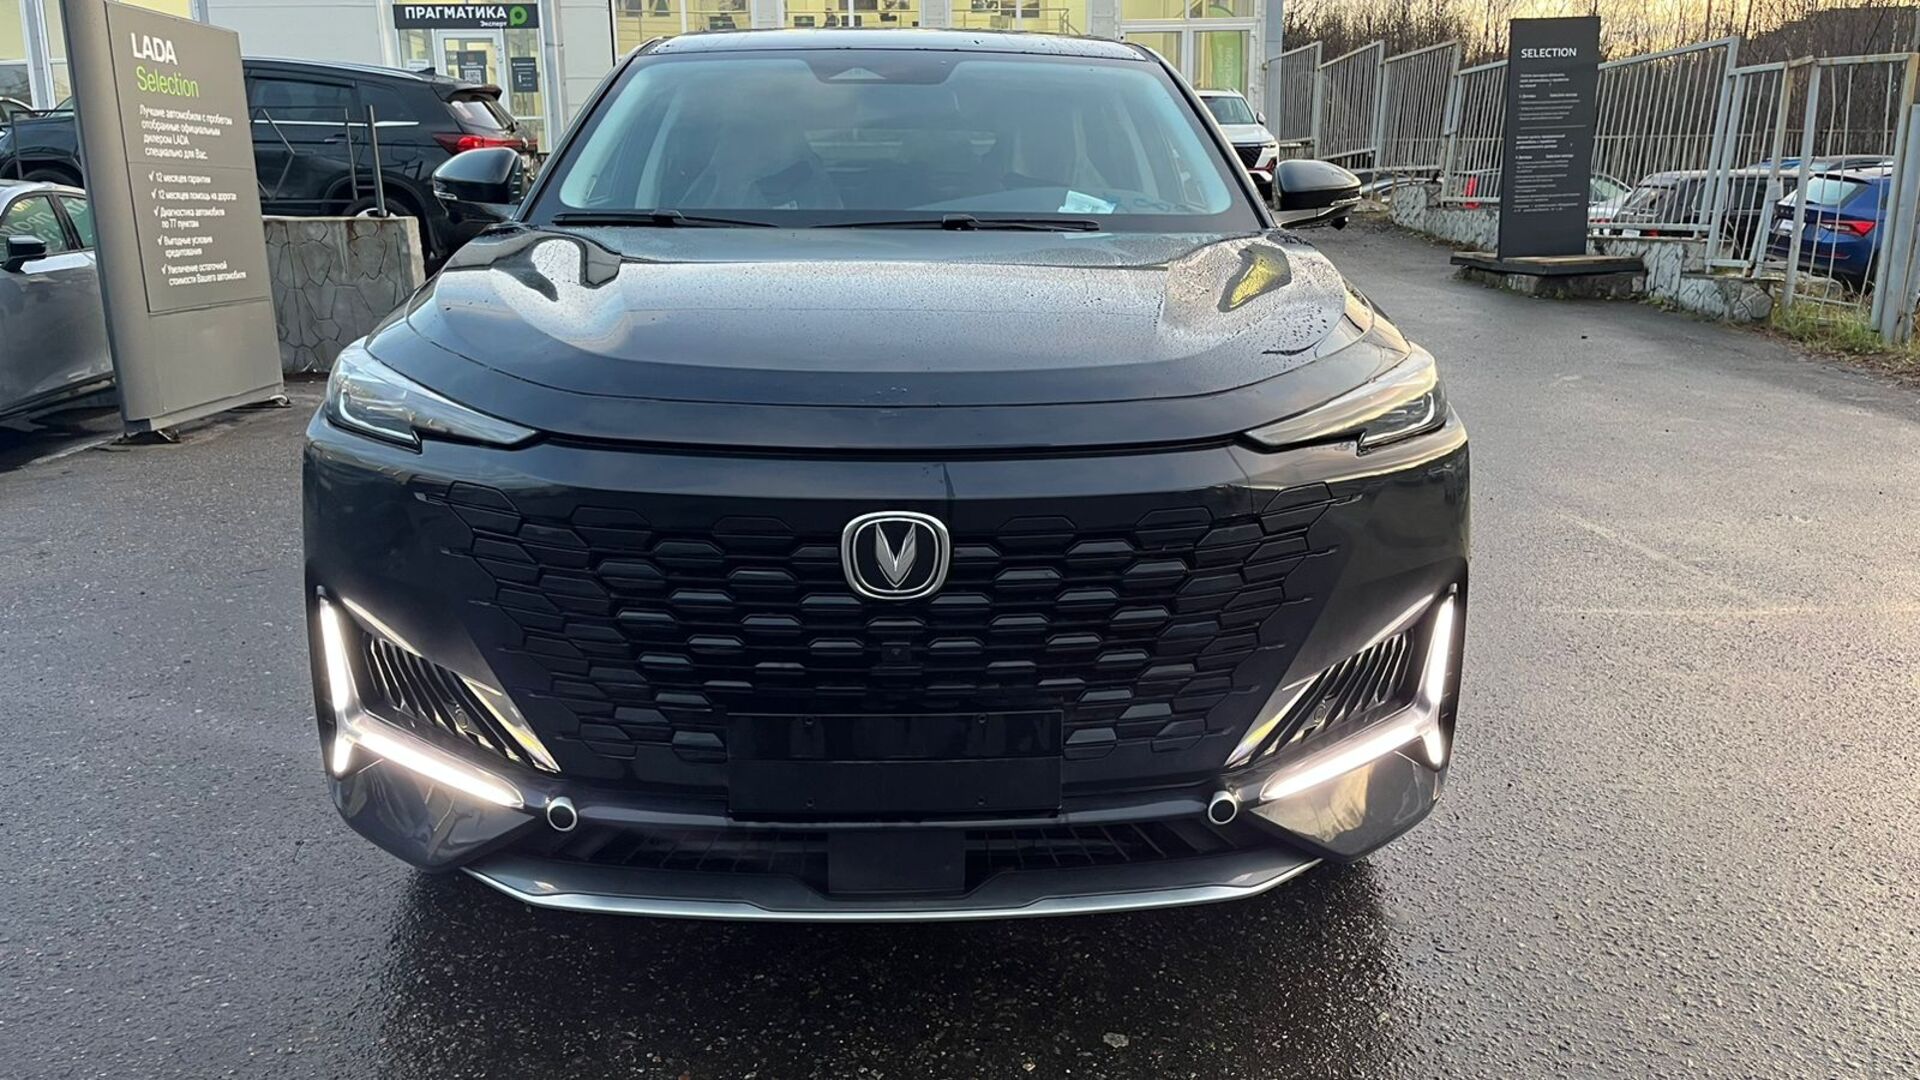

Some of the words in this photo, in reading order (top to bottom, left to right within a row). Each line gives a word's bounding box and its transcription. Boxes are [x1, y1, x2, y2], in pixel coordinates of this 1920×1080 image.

[405, 6, 507, 19] ПРАГМАТИКА
[131, 32, 178, 65] LADA
[1521, 48, 1577, 58] SELECTION
[136, 65, 199, 98] Selection
[140, 104, 165, 117] Лучшие
[166, 110, 201, 122] автомобили
[142, 120, 180, 132] отобранные
[181, 124, 220, 135] официальным
[144, 135, 172, 144] дилером
[173, 135, 190, 144] LADA
[145, 148, 183, 157] специально
[184, 150, 194, 159] для
[156, 172, 163, 182] 12
[164, 174, 187, 184] месяцев
[158, 189, 166, 200] 12
[166, 192, 189, 201] месяцев
[160, 207, 194, 217] Диагностика
[164, 236, 191, 245] Выгодные
[192, 236, 213, 245] условия
[165, 248, 202, 258] кредитования
[167, 264, 198, 274] Увеличение
[169, 277, 196, 285] стоимости
